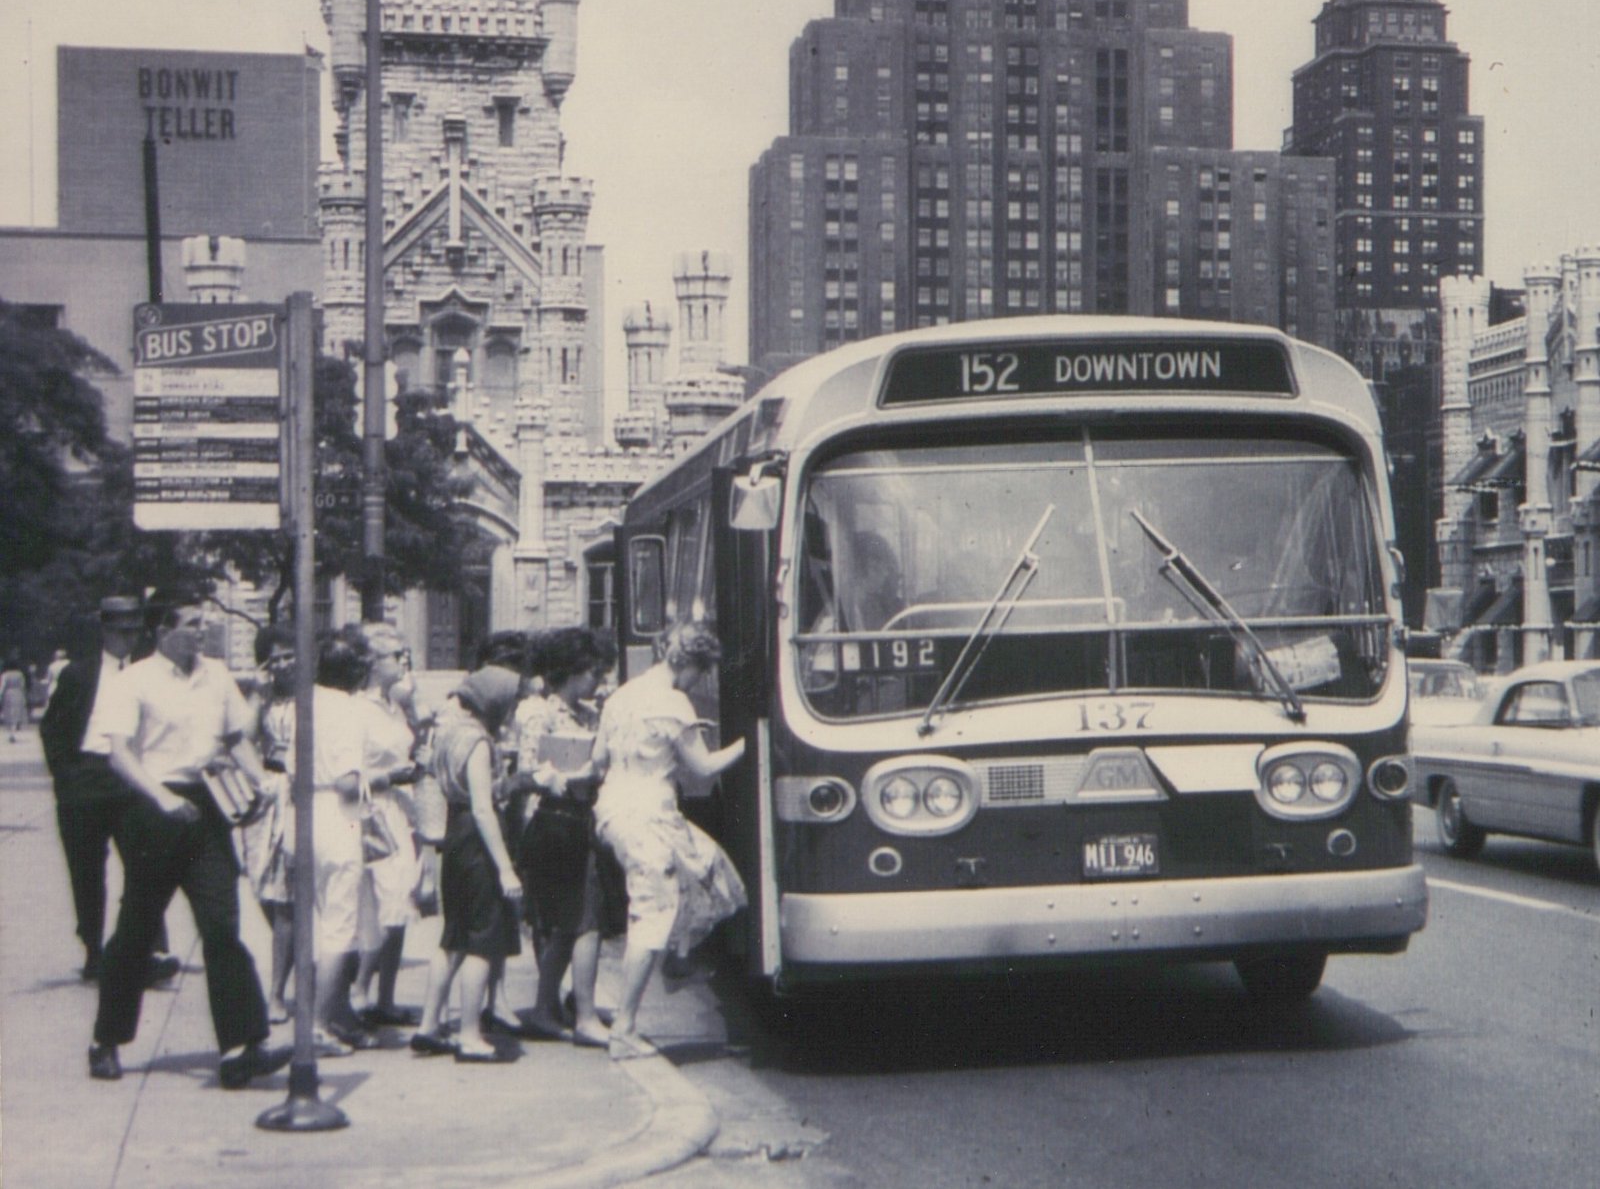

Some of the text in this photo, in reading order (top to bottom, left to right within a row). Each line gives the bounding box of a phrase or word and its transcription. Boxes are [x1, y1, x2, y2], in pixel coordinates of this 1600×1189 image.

[138, 67, 240, 101] BONWIT
[143, 106, 237, 140] TELLER
[146, 319, 268, 360] BUS STOP
[960, 351, 1221, 393] 152 DOWNTOWN
[872, 639, 935, 669] 192
[1076, 702, 1155, 732] 137
[1095, 763, 1139, 789] GM
[1123, 843, 1155, 866] 946
